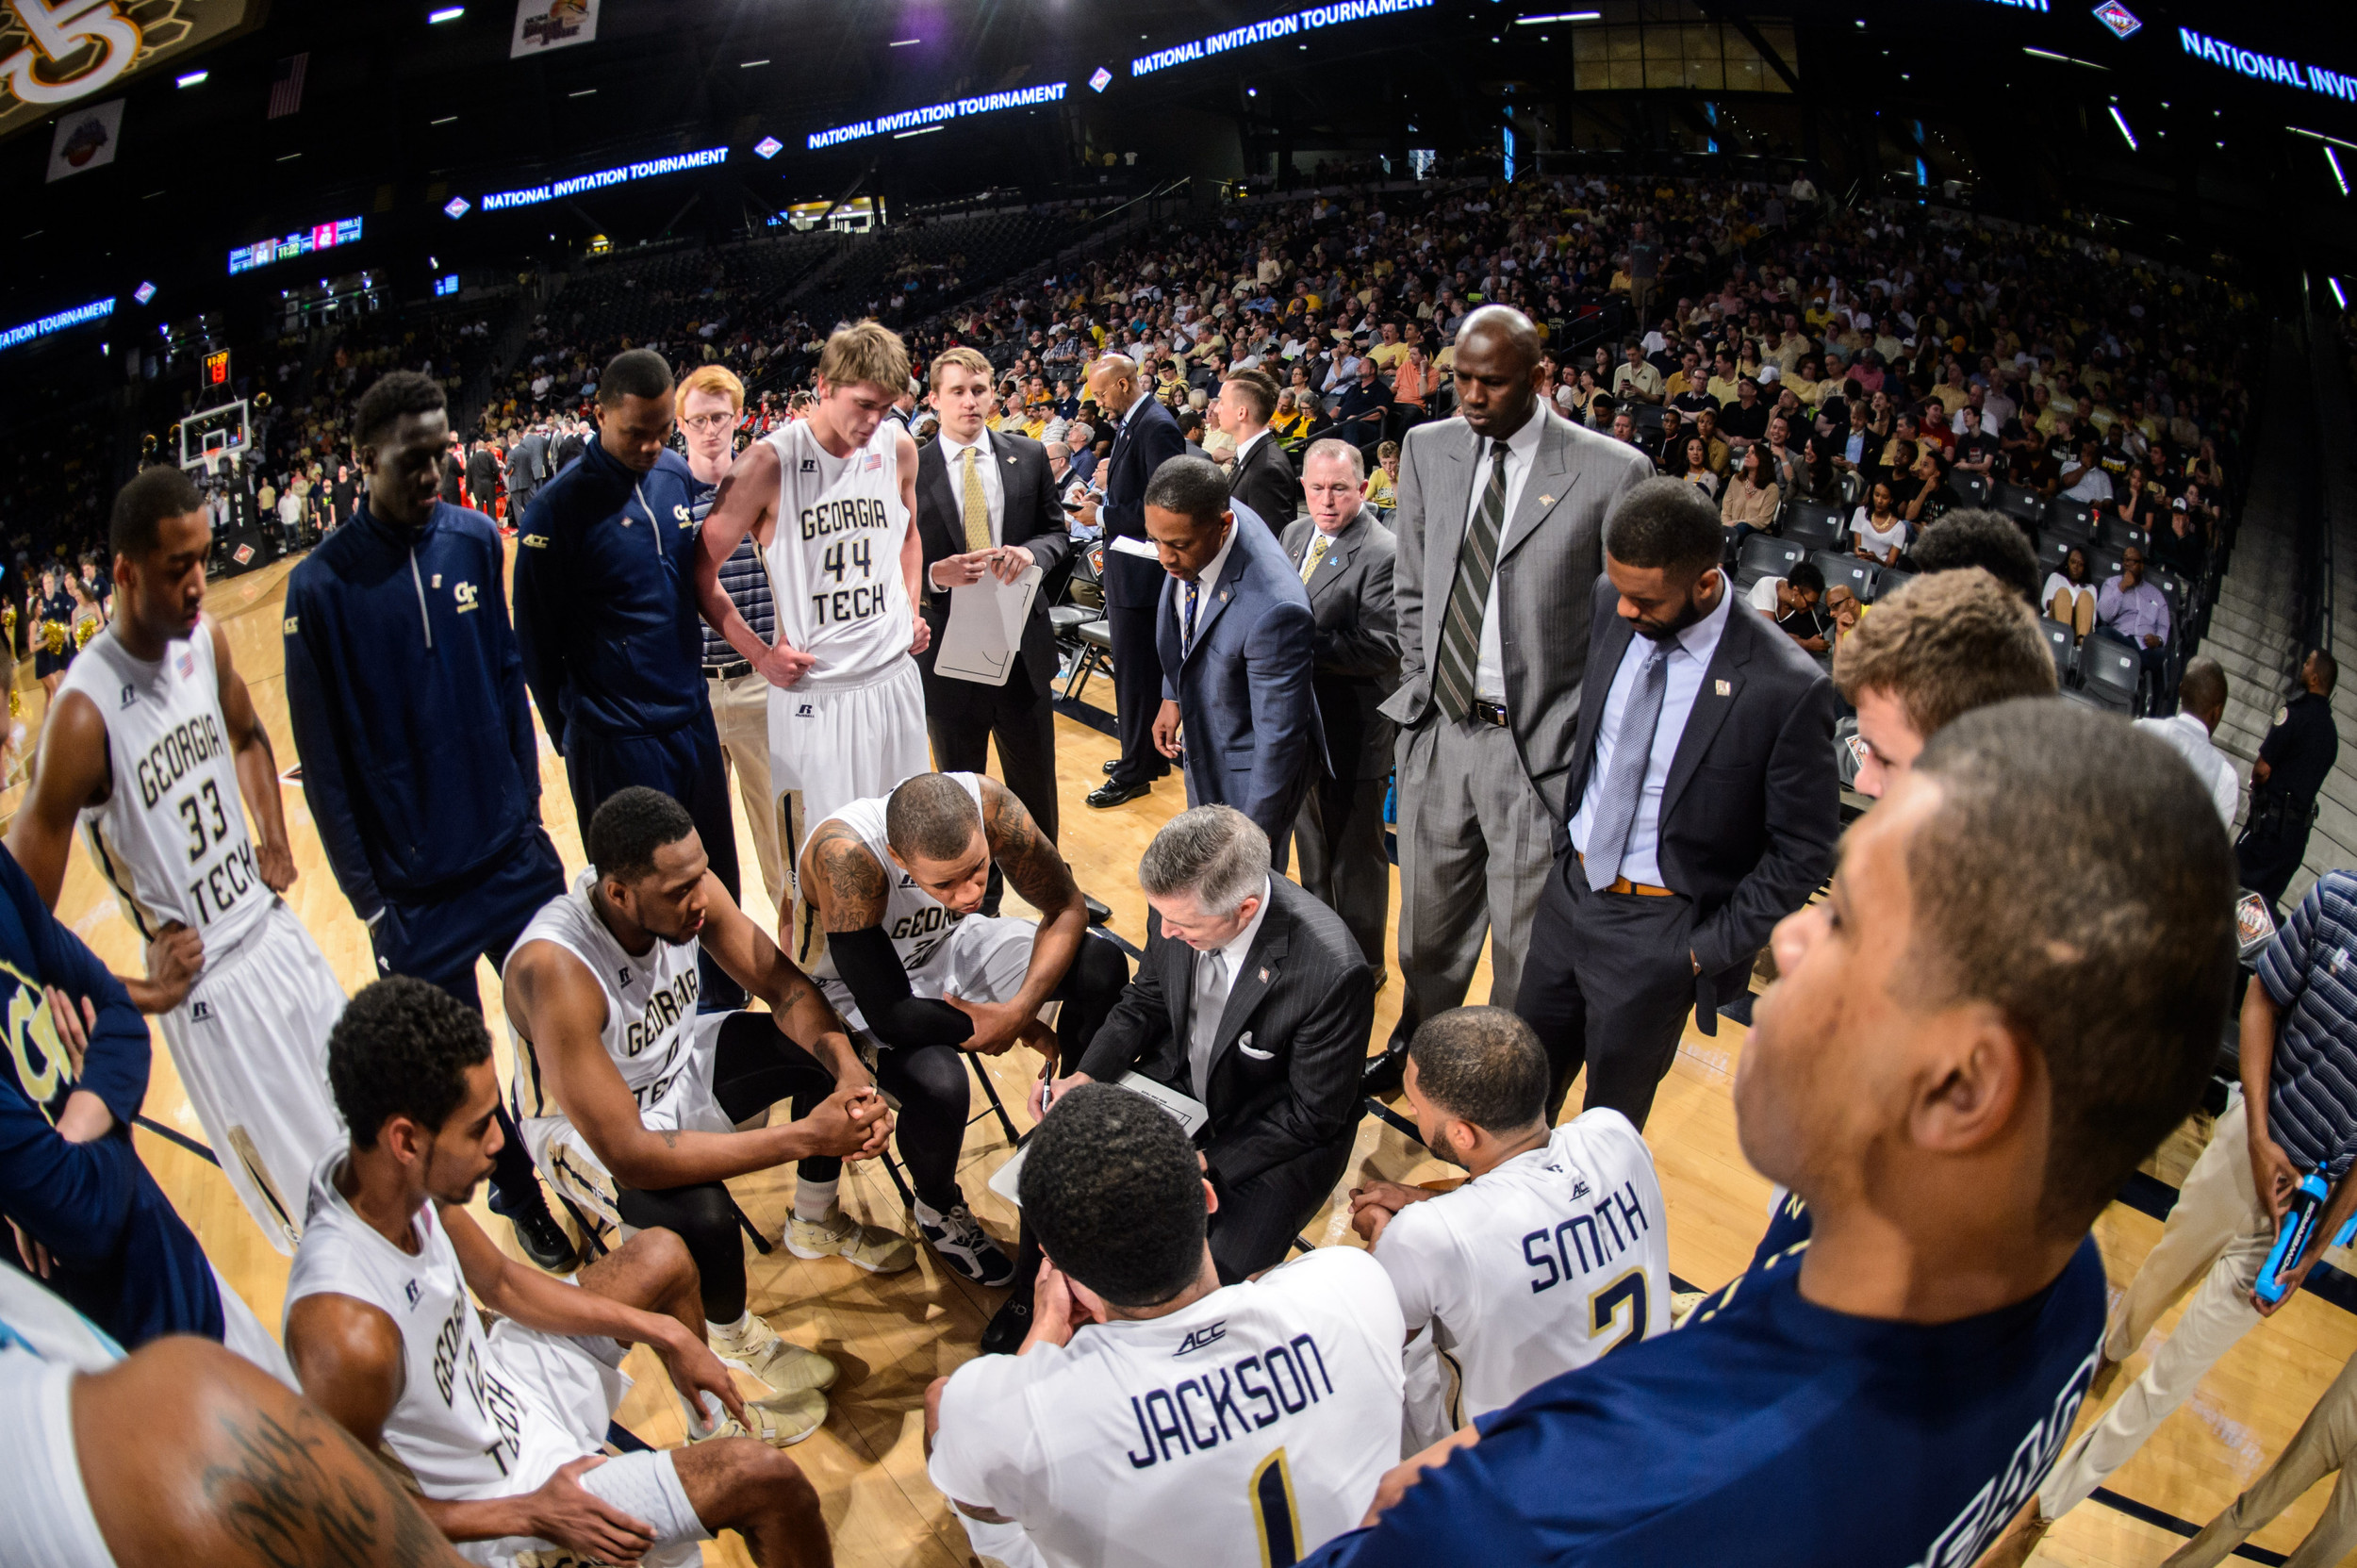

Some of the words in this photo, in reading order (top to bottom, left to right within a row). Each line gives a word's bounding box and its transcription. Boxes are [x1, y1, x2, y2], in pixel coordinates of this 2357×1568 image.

[1132, 41, 1204, 76] NATIONAL
[1205, 13, 1298, 55] INVITATION
[2178, 26, 2307, 90] NATIONAL
[808, 121, 875, 149] NATIONAL
[877, 102, 955, 133] INVITATION
[957, 82, 1067, 116] TOURNAMENT
[482, 185, 552, 210] NATIONAL
[553, 167, 628, 197] INVITATION
[629, 146, 730, 179] TOURNAMENT
[256, 250, 269, 263] 64
[278, 243, 301, 259] 11:22
[319, 232, 333, 246] 42
[37, 296, 117, 336] TOURNAMENT
[207, 352, 228, 369] 11:22
[522, 533, 550, 549] ACC
[800, 497, 889, 542] GEORGIA
[824, 536, 872, 583] 44
[284, 616, 299, 635] CC
[812, 582, 886, 626] TECH
[138, 713, 224, 811] GEORGIA
[179, 778, 229, 865] 33
[190, 837, 255, 926] TECH
[626, 967, 701, 1059] GEORGIA
[1522, 1180, 1649, 1295] SMTH
[1173, 1319, 1228, 1356] ACC
[484, 1369, 520, 1477] TECH
[1128, 1333, 1334, 1470] JACKSON
[1248, 1444, 1305, 1568] 1
